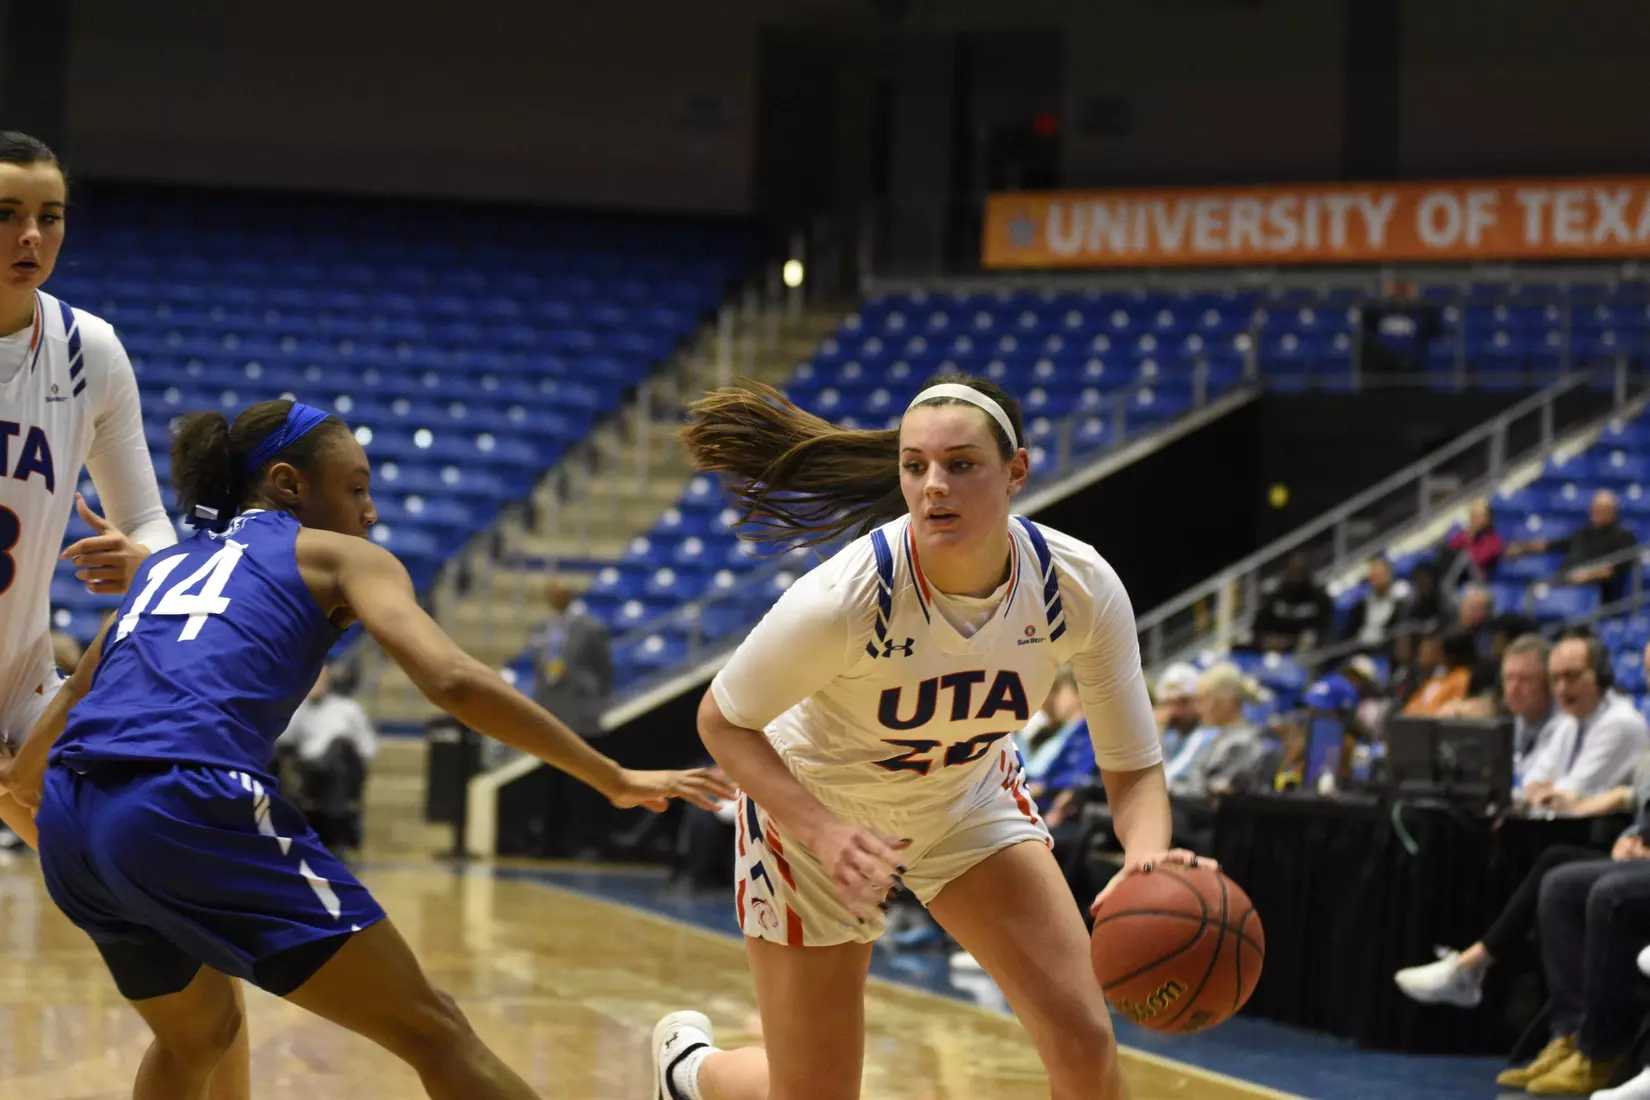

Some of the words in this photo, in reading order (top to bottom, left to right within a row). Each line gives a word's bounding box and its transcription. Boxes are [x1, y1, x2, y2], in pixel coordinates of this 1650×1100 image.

[1046, 189, 1396, 256] UNIVERSITY
[1415, 188, 1500, 250] OF
[114, 539, 249, 643] 14
[878, 669, 1030, 730] UTA
